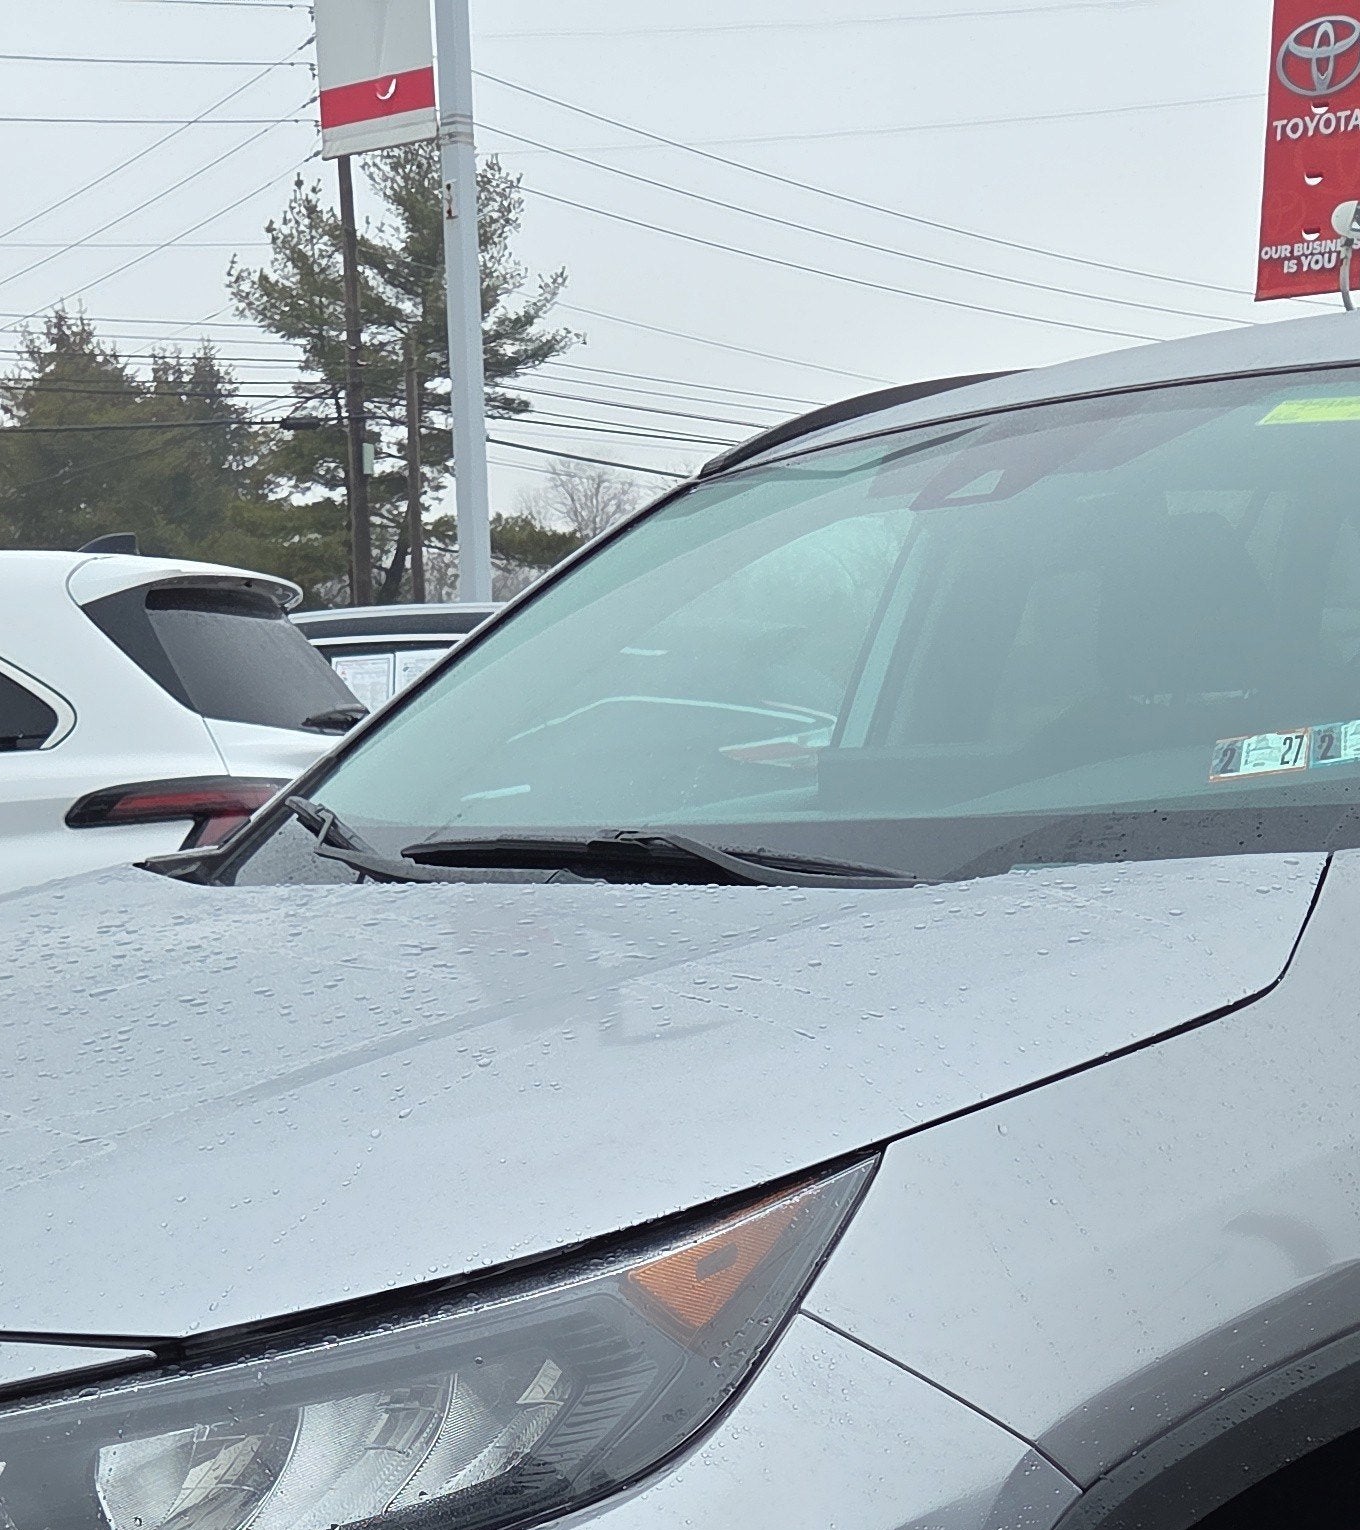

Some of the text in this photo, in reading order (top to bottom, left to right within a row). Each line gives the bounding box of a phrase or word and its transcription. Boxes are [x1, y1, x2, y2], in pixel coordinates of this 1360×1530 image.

[1260, 246, 1292, 260] OUR
[1283, 252, 1337, 273] IS YOU
[1220, 749, 1237, 773] 2
[1280, 735, 1304, 766] 27
[1318, 733, 1335, 761] 2
